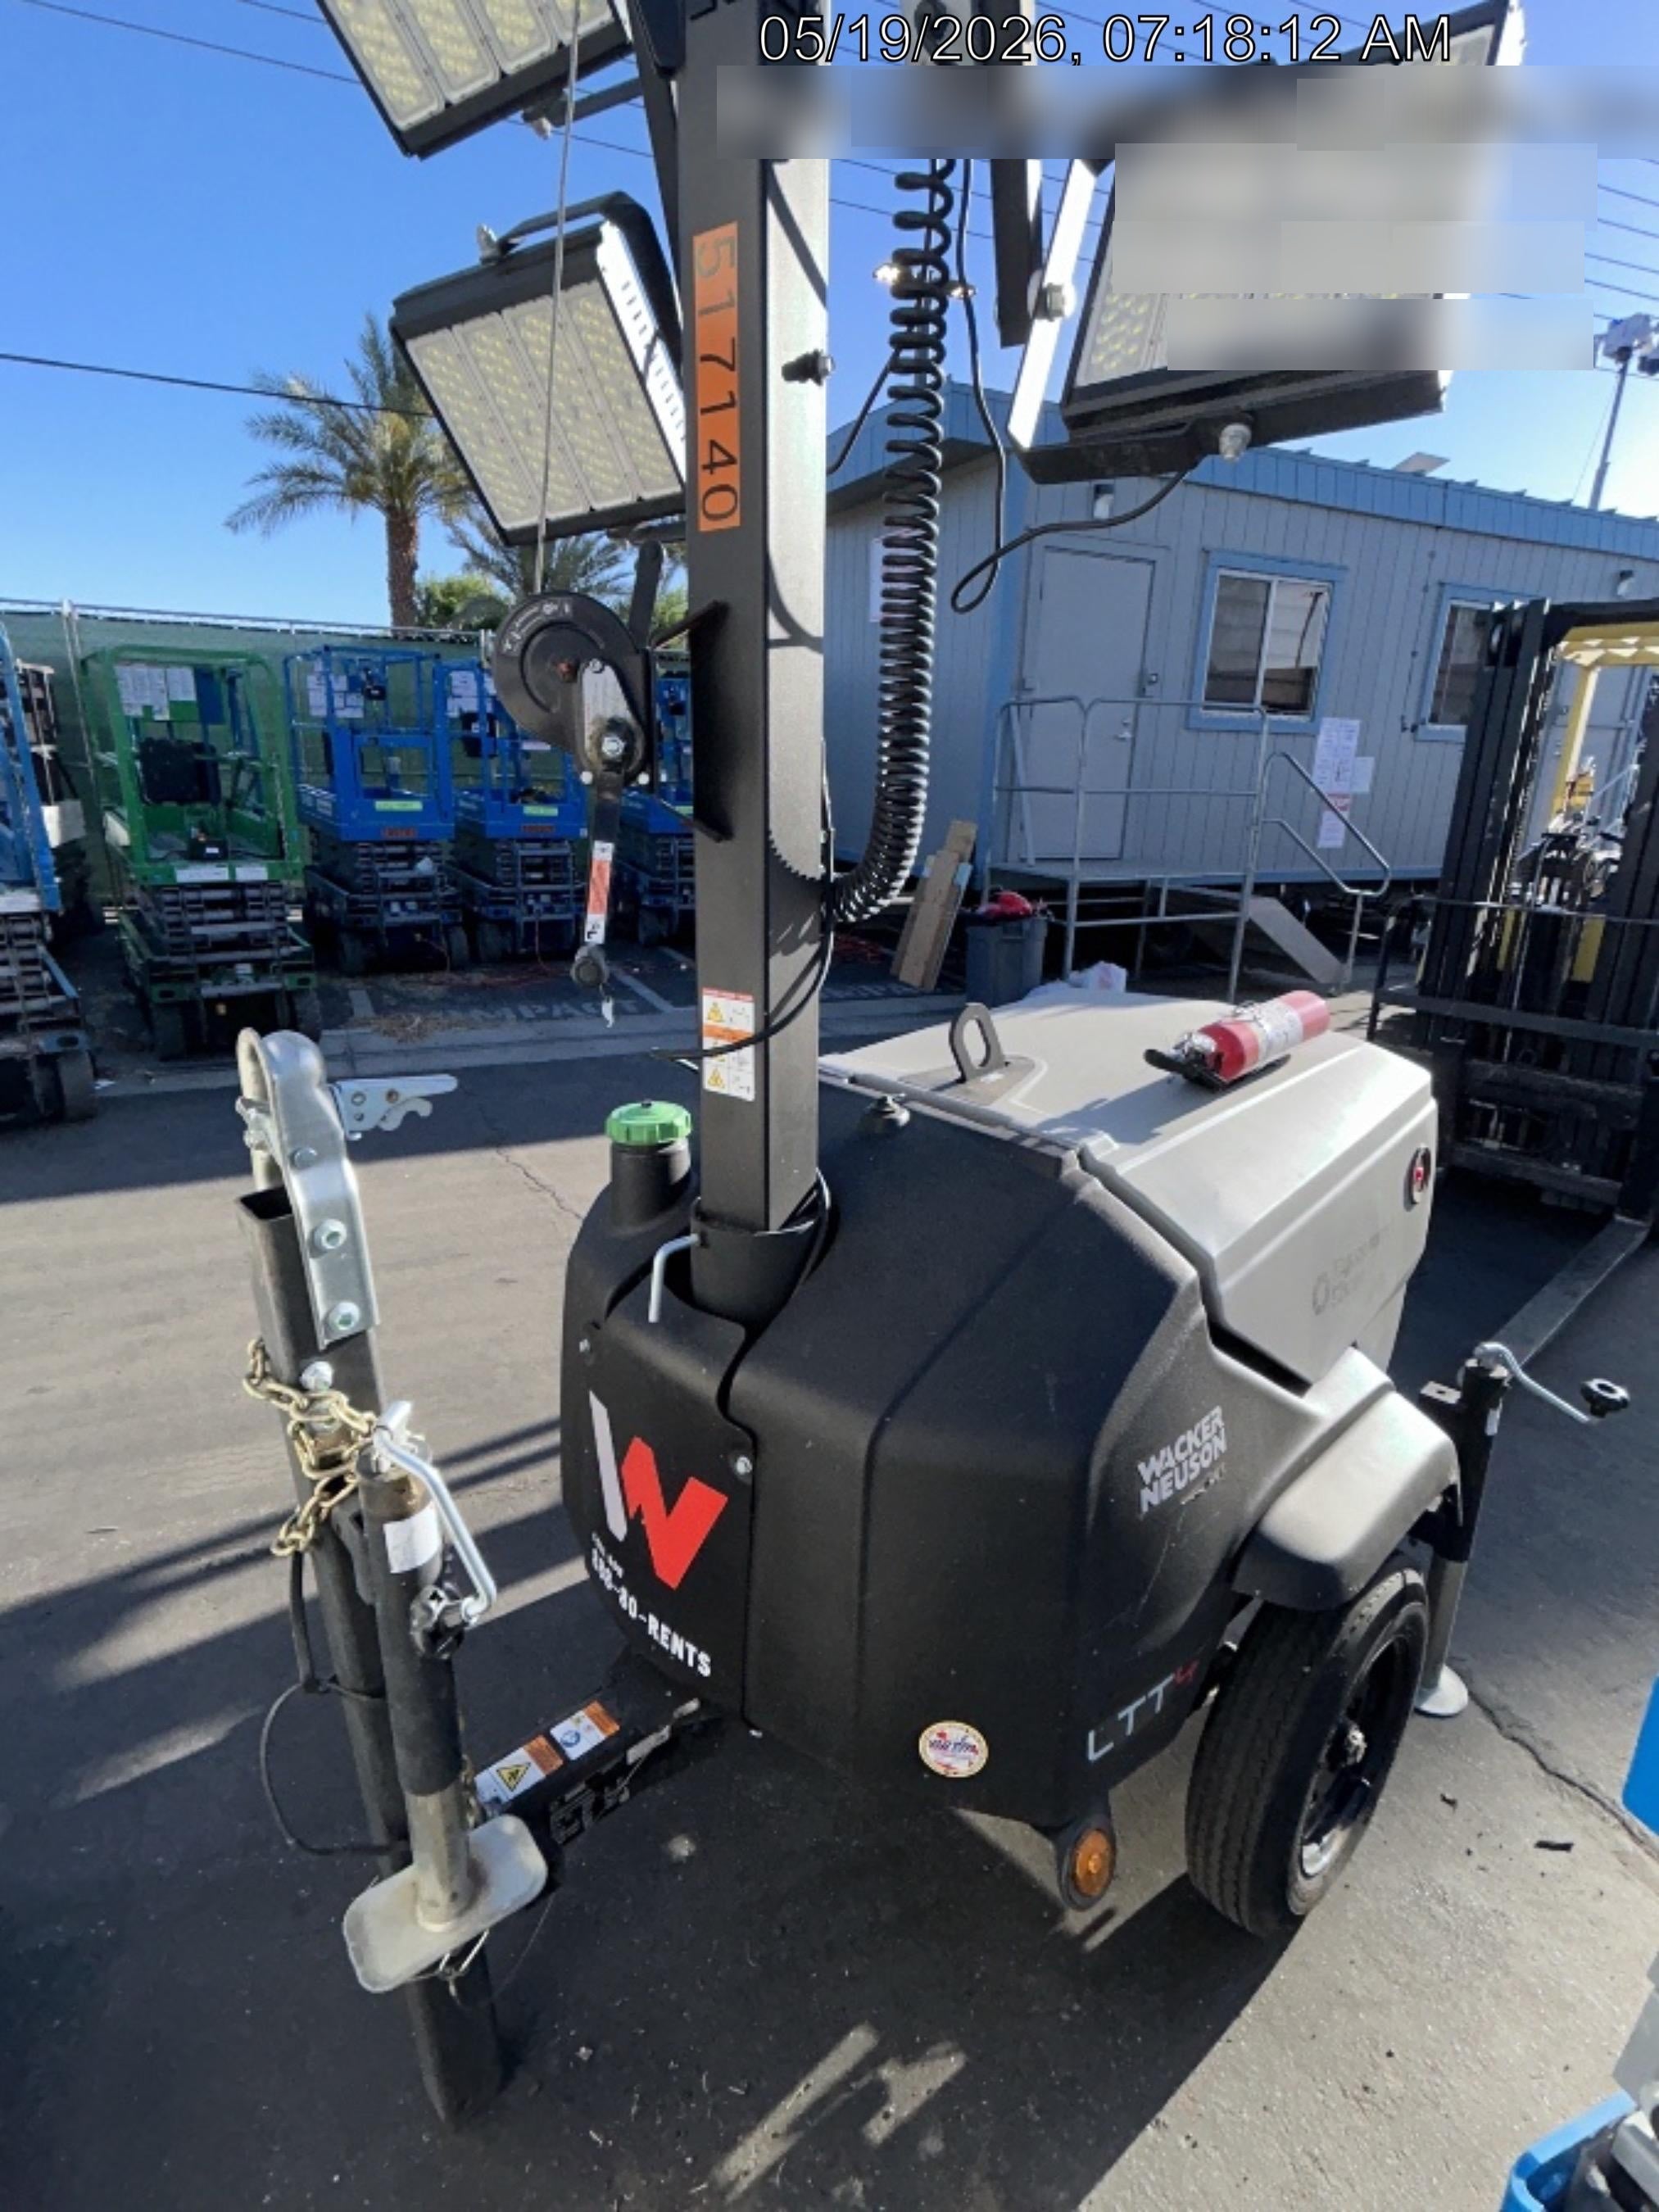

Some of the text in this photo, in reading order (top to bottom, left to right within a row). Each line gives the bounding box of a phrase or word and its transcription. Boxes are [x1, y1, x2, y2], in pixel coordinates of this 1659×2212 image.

[697, 237, 737, 521] 5171140
[1137, 1405, 1225, 1484] WACKER
[1140, 1427, 1227, 1513] NEUSON
